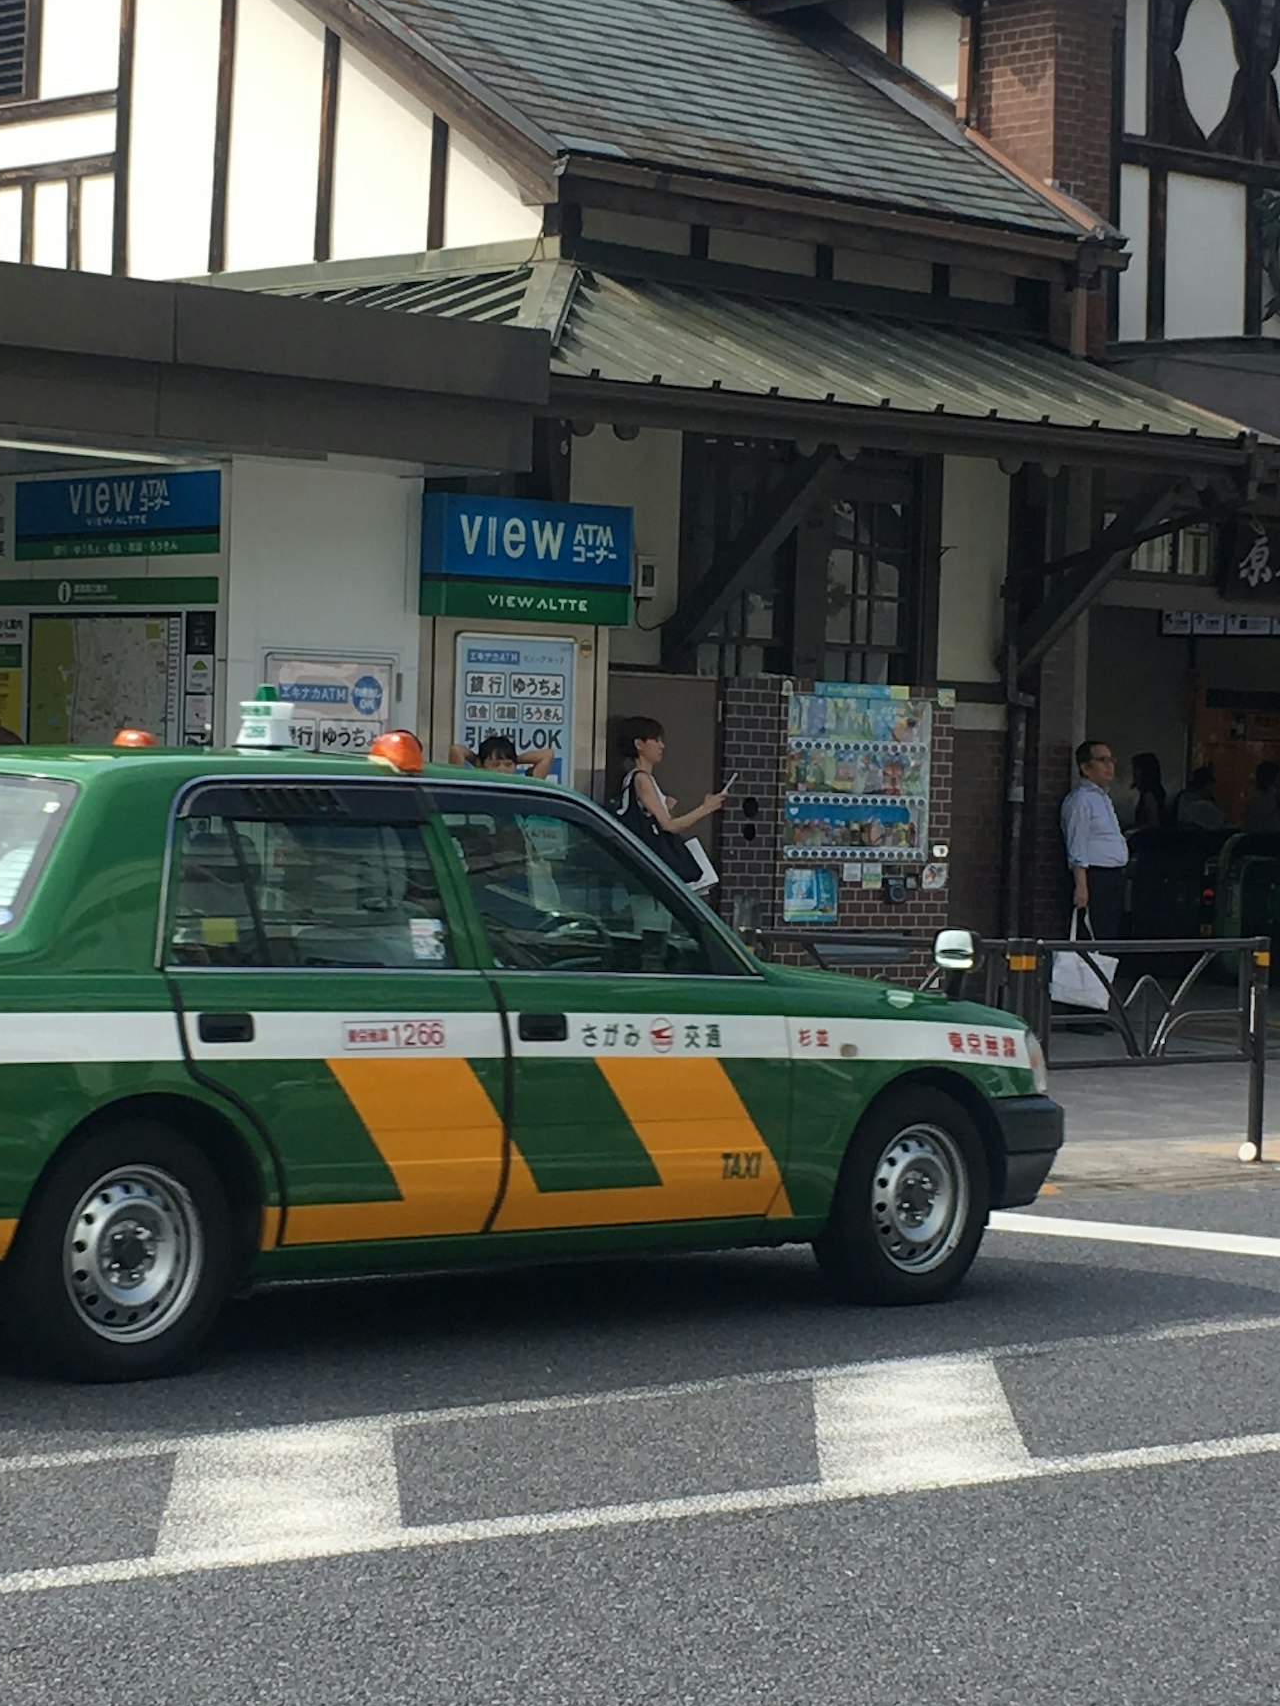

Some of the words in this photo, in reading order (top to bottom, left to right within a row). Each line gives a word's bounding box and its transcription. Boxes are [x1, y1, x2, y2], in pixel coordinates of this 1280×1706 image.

[139, 479, 169, 498] ATM
[139, 497, 171, 512] コーナー
[573, 523, 615, 548] ATM
[572, 545, 618, 565] コーナー
[487, 594, 535, 609] VIEW
[536, 597, 589, 613] ALTTE
[280, 684, 347, 702] エキナカATM
[470, 675, 503, 694] 銀行
[512, 677, 562, 697] ゆうちょ
[467, 704, 489, 719] 信金
[524, 706, 563, 722] ろうきん
[289, 725, 314, 745] 行
[391, 1022, 445, 1048] 1266
[581, 1022, 641, 1048] さがみ
[684, 1023, 722, 1049] 交通
[796, 1026, 830, 1048] 杉並
[947, 1029, 1018, 1059] 東京無線
[721, 1151, 762, 1180] TAXI
